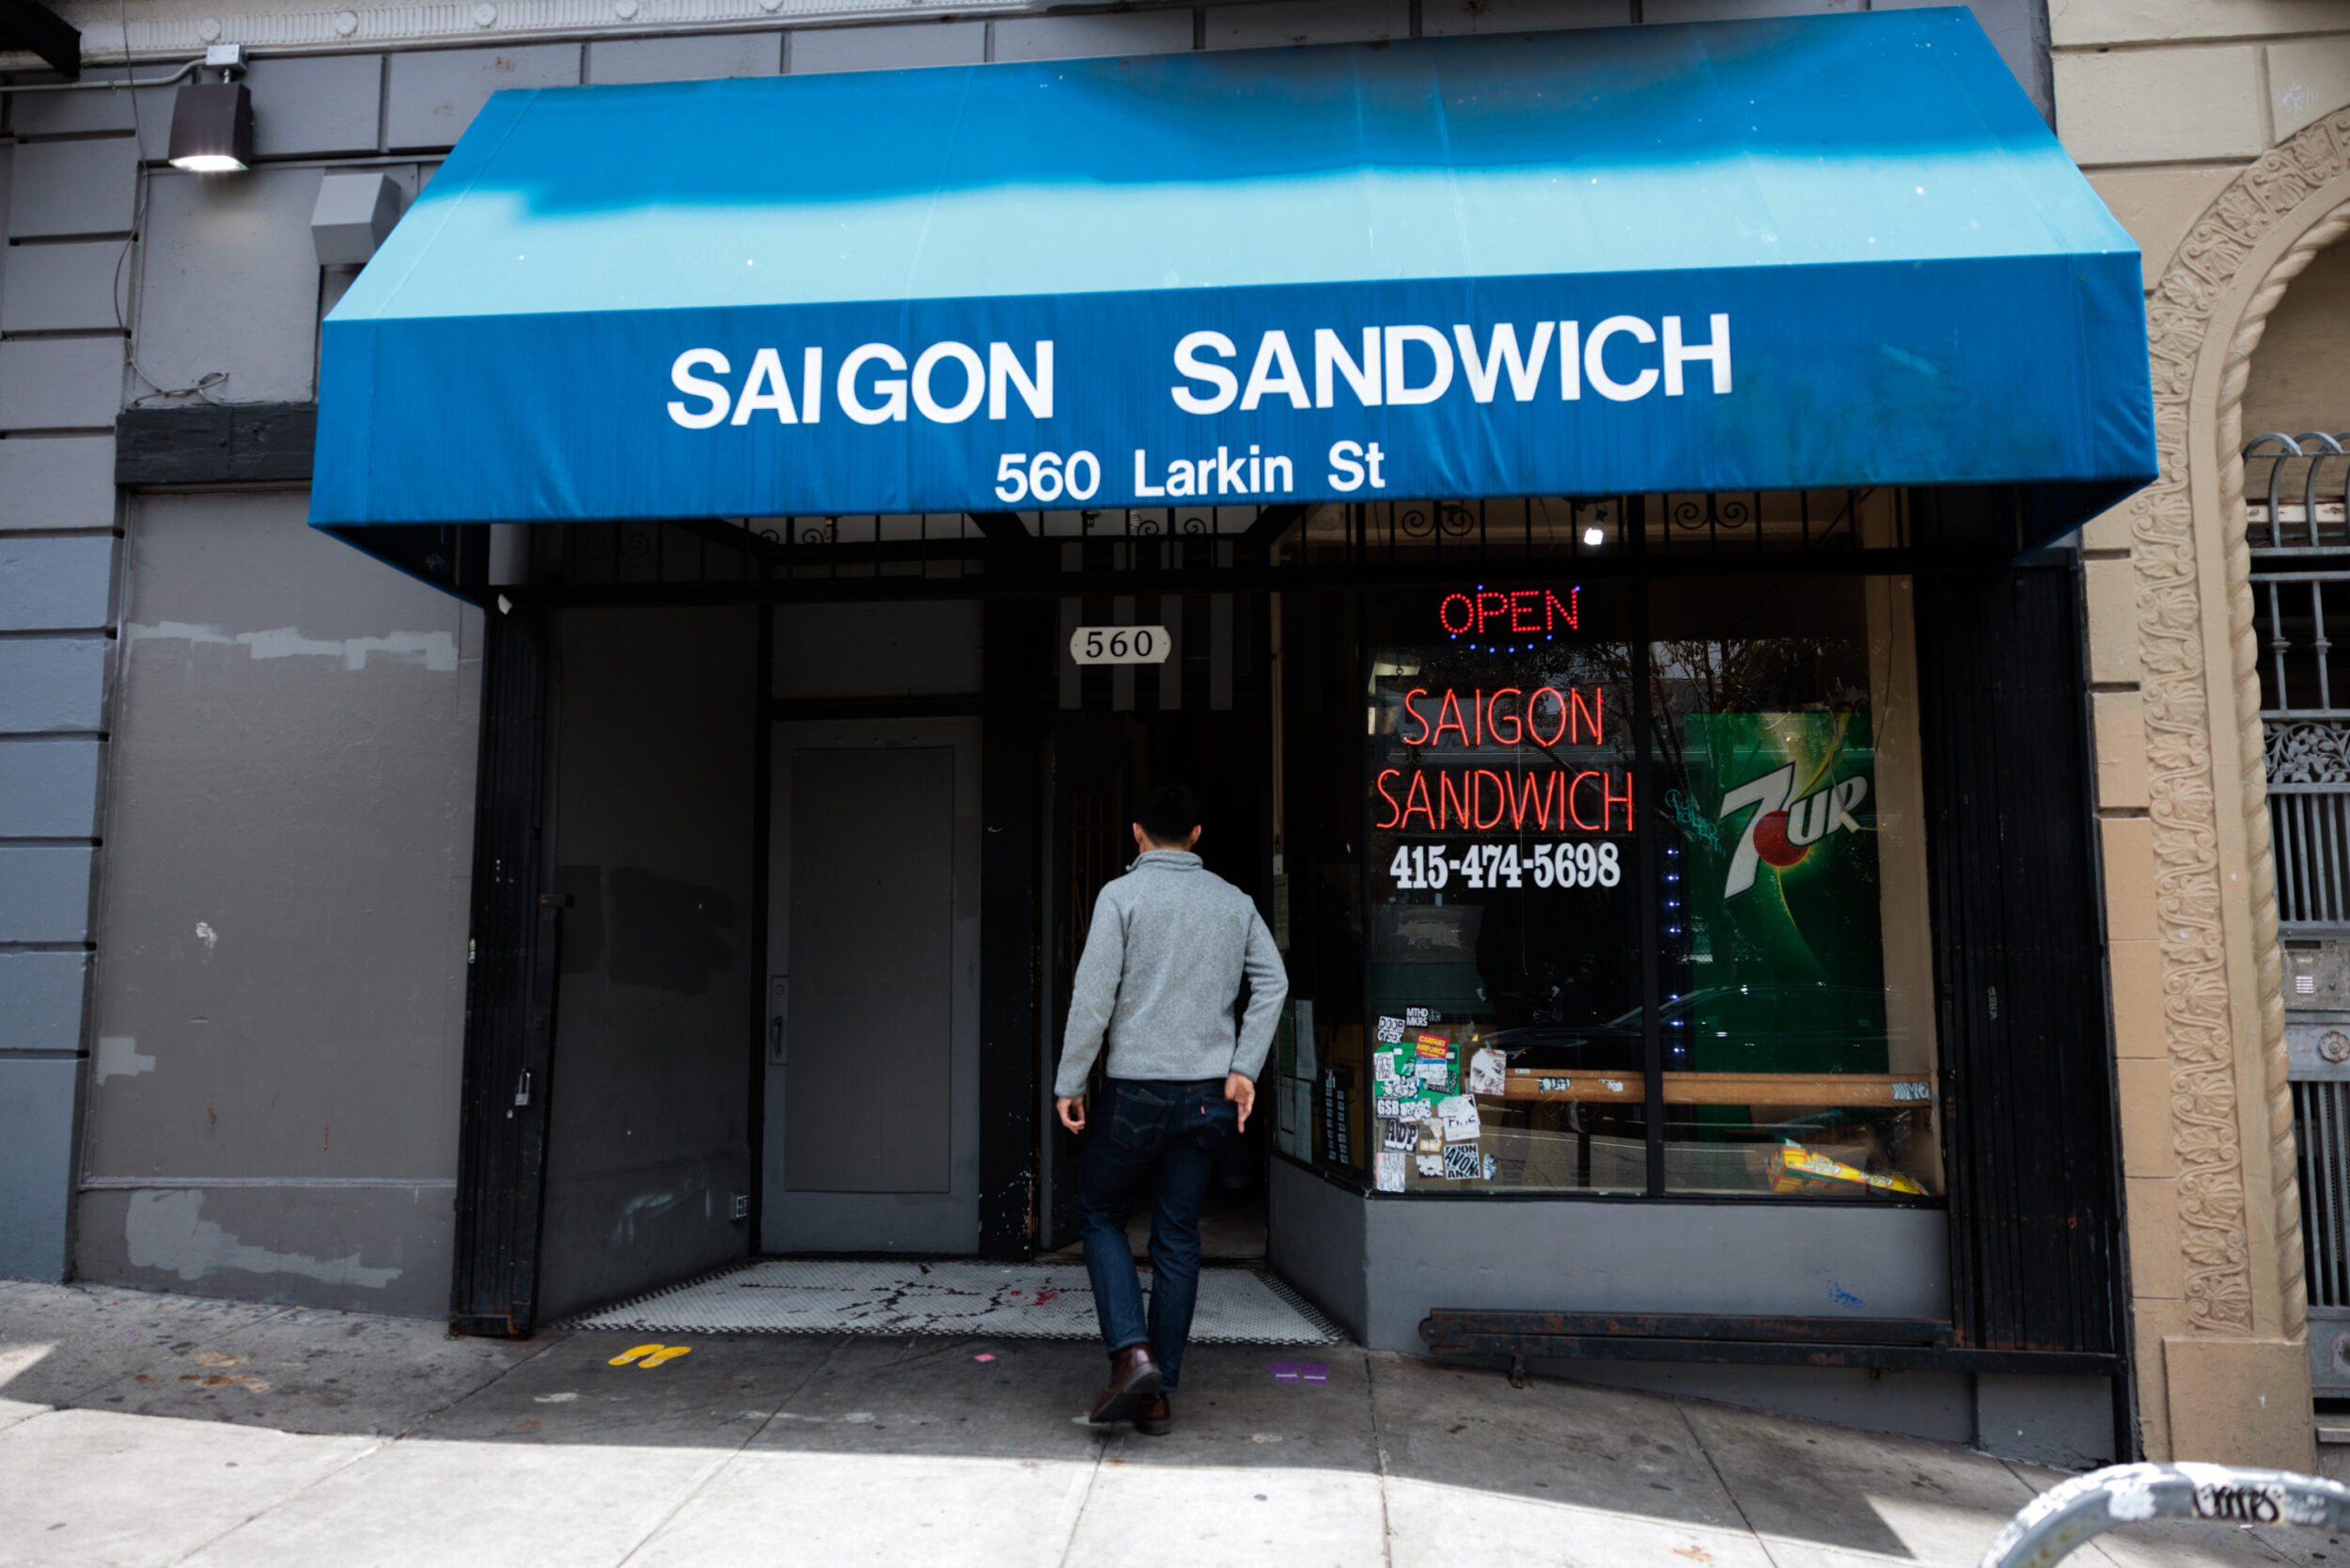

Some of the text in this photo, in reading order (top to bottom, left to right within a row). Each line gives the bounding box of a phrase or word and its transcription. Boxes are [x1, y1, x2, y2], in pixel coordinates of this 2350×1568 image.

[667, 313, 1732, 430] SAIGON SANDWICH
[995, 440, 1386, 502] 560 Larkin St
[1440, 588, 1578, 634] OPEN
[1086, 630, 1153, 658] 560
[1404, 687, 1604, 746] SAIGON
[1376, 769, 1634, 832] SANDWICH
[1389, 842, 1621, 889] 415-474-5698
[1406, 1007, 1429, 1016] MTHD
[1406, 1016, 1428, 1027] MKRS
[1377, 1099, 1400, 1116] GSB
[1444, 1147, 1479, 1177] AVON
